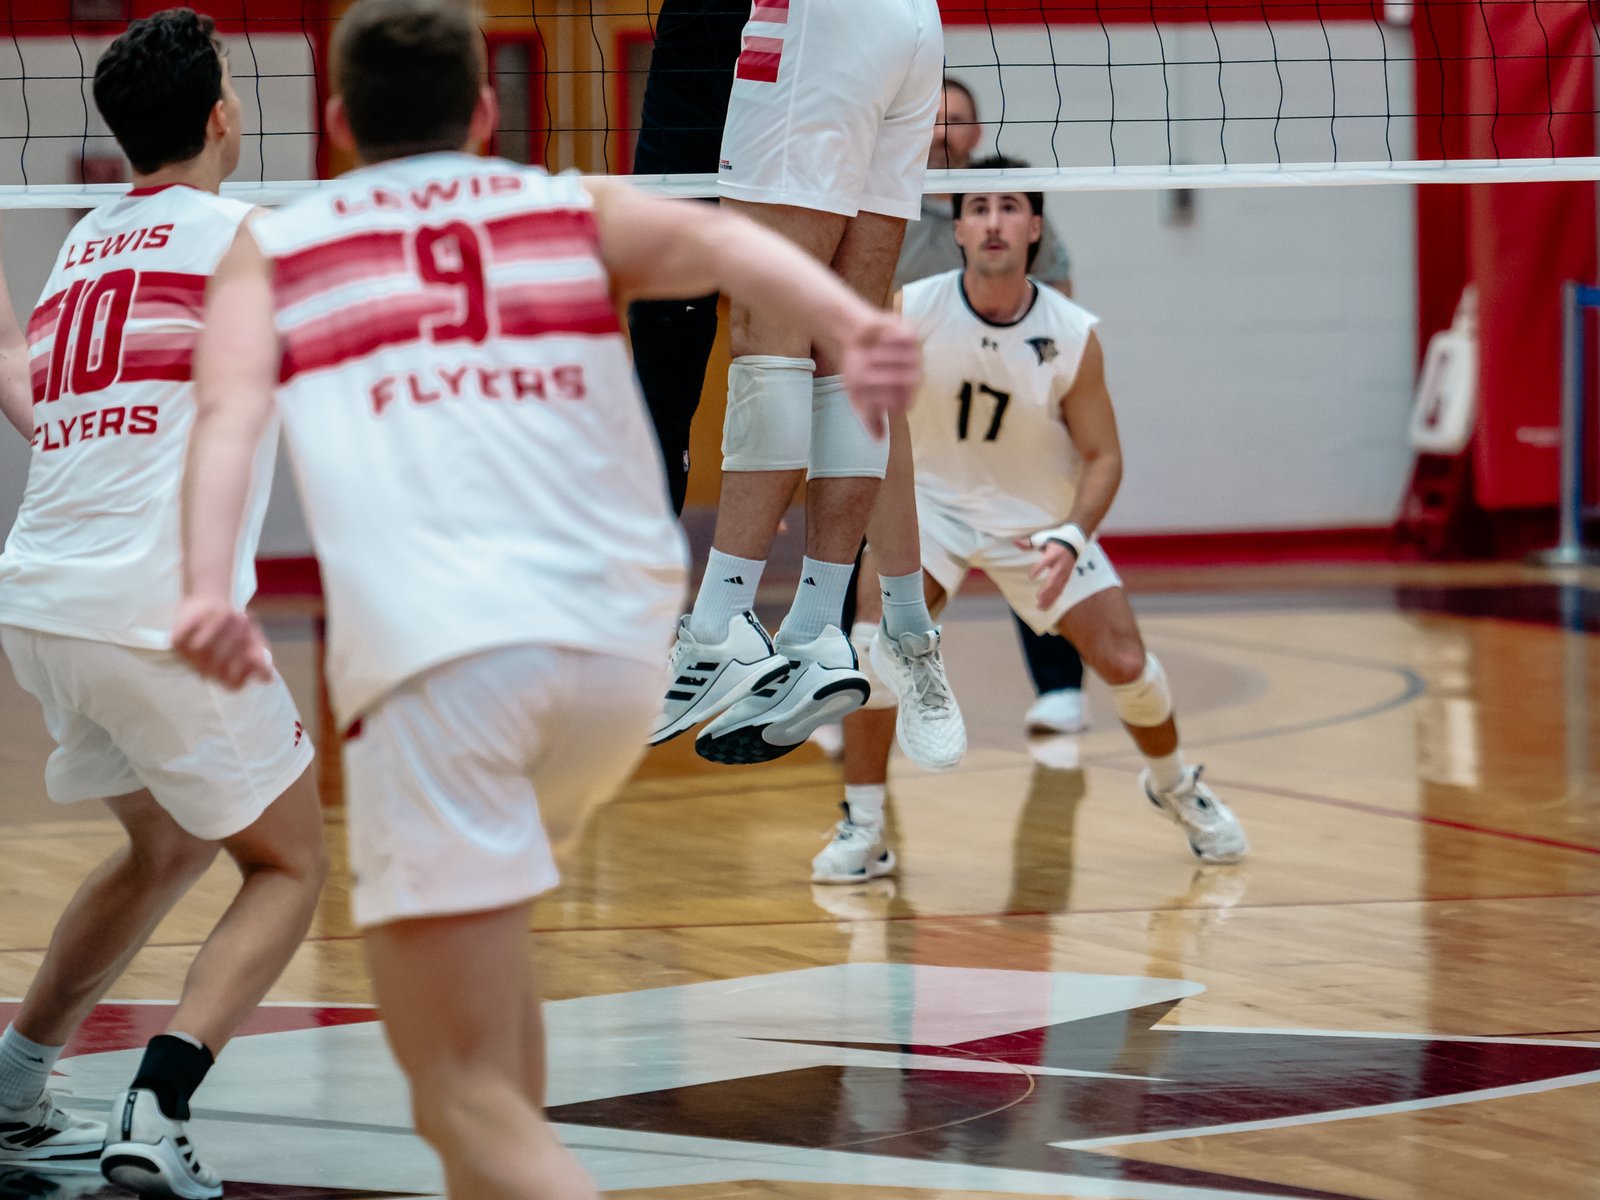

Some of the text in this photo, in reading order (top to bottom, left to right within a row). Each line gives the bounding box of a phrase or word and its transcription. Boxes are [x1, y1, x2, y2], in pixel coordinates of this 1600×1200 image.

[63, 223, 175, 271] LEWIS
[414, 219, 489, 346] 9
[45, 267, 136, 404] 10
[369, 363, 588, 417] FLYERS
[956, 380, 1011, 442] 17
